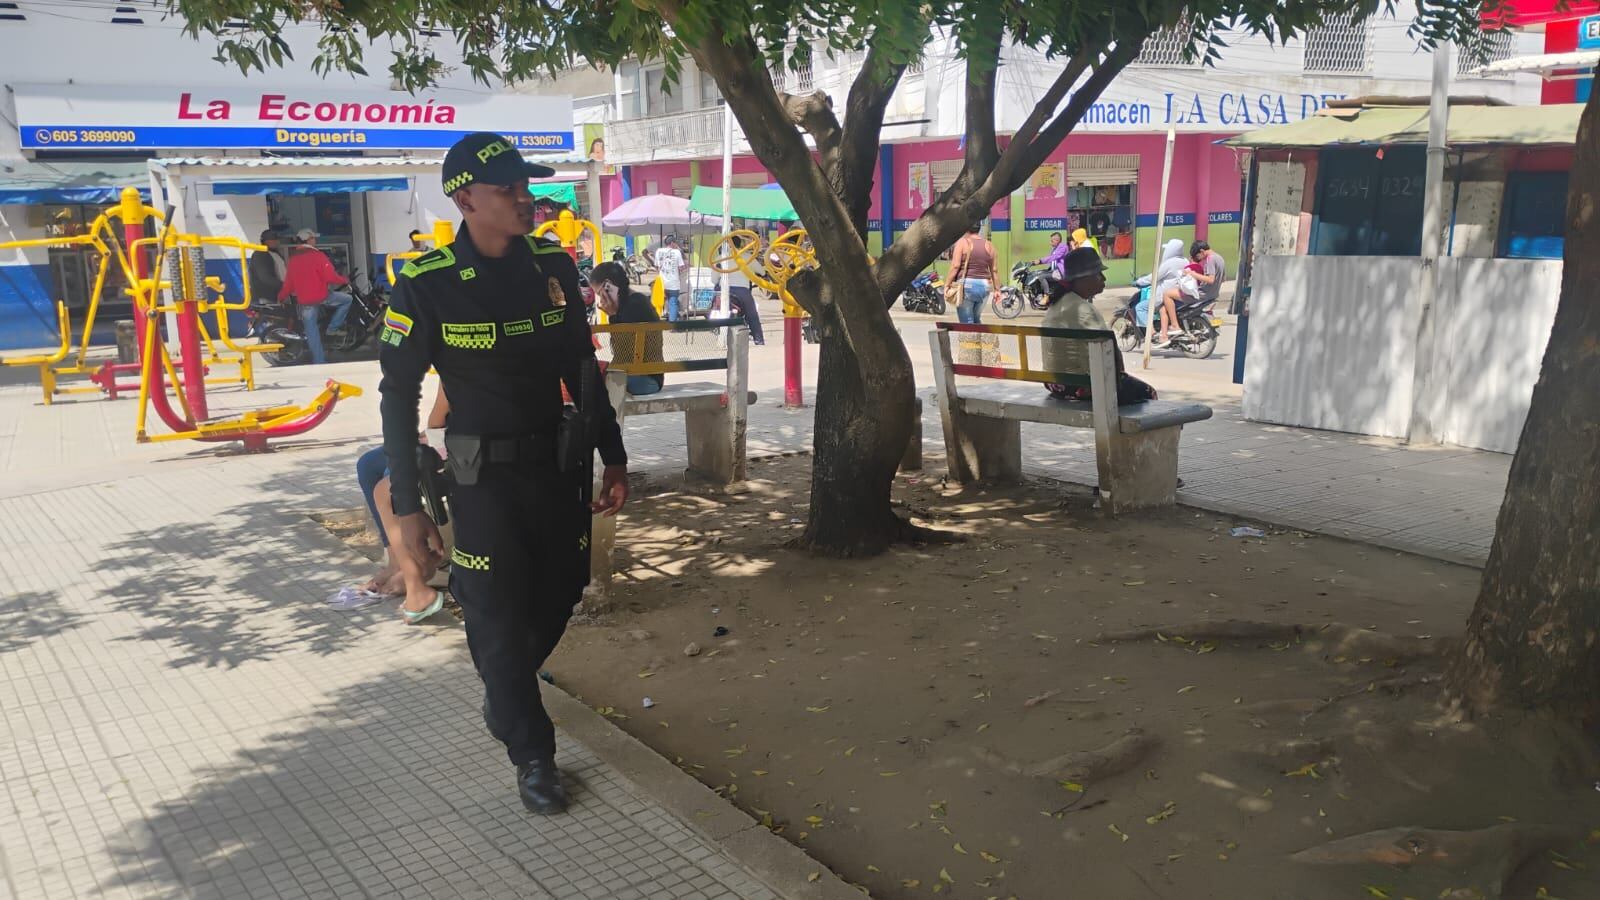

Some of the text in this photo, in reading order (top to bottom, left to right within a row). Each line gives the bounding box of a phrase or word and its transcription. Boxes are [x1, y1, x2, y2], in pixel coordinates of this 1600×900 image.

[178, 93, 456, 124] La Economía
[1164, 93, 1208, 124] LA
[1219, 93, 1288, 125] CASA
[52, 130, 136, 143] 605 3699090
[276, 128, 366, 146] Droguería
[522, 135, 563, 147] 5330670
[1040, 219, 1062, 229] HOGAR
